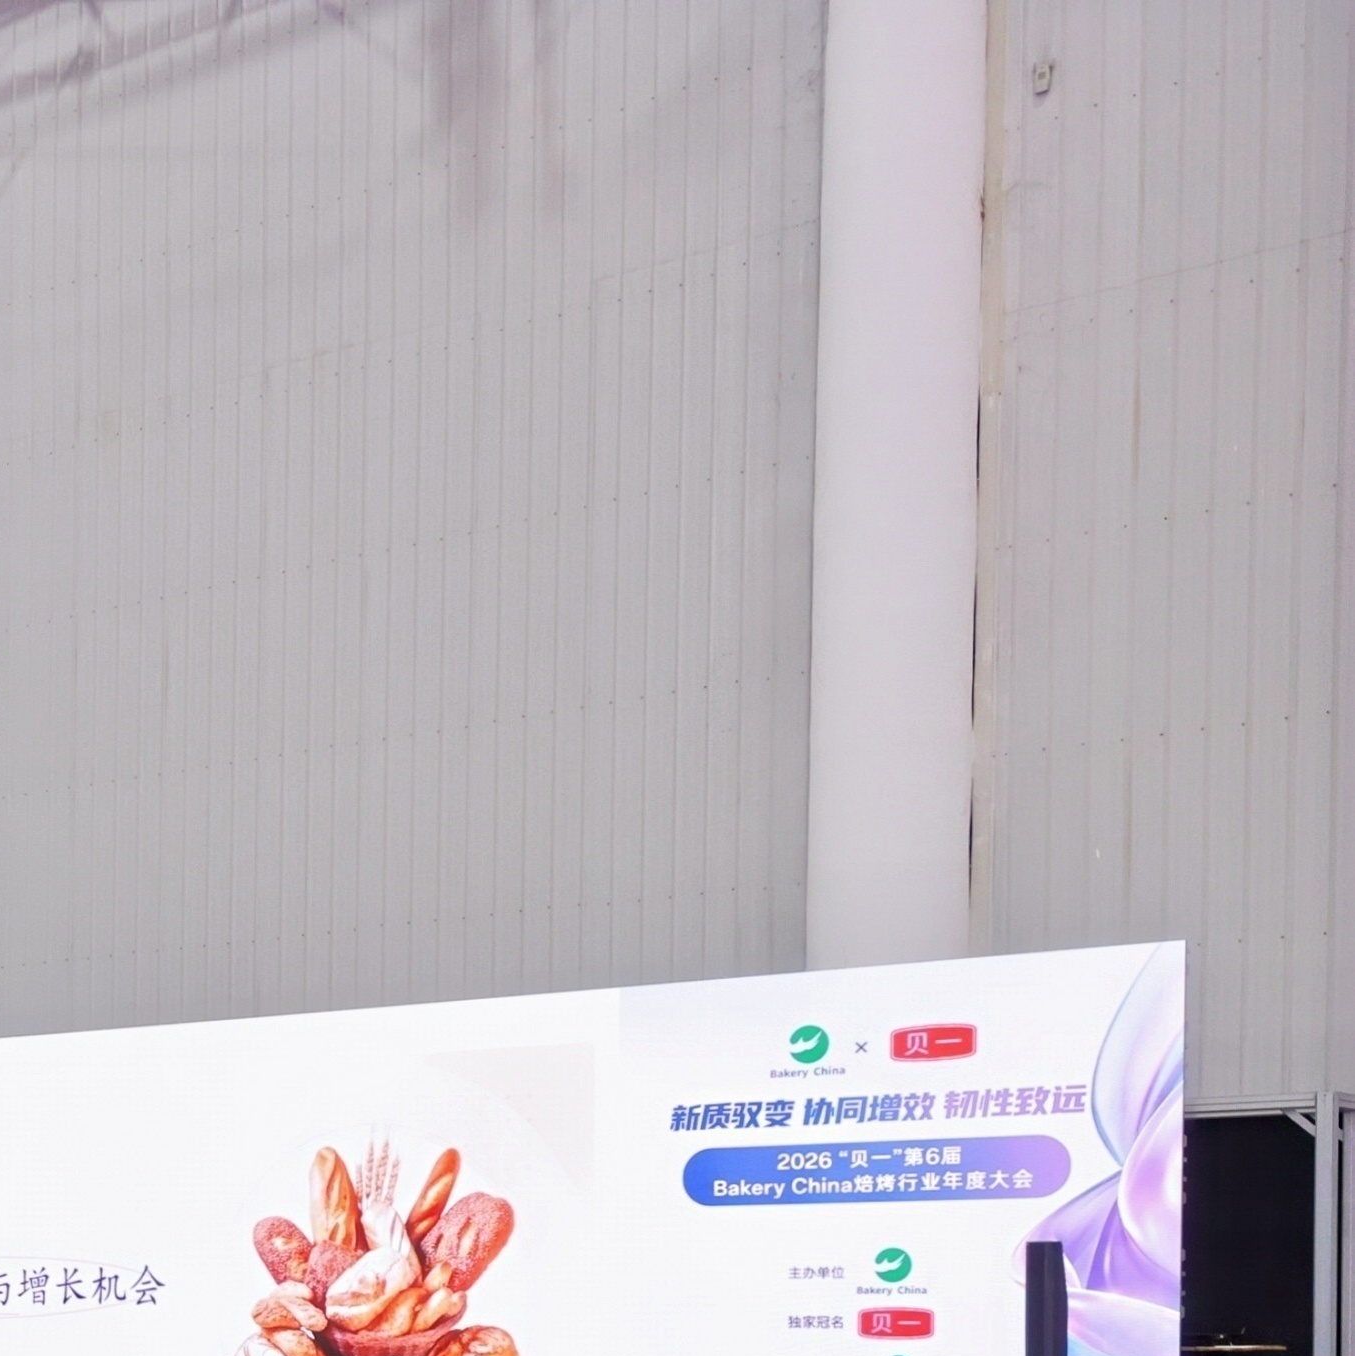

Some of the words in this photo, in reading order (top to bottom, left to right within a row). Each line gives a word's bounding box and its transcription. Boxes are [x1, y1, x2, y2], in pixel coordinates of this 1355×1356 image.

[904, 1032, 962, 1055] 贝一
[770, 1068, 808, 1079] Bakery
[813, 1066, 846, 1076] China
[670, 1100, 794, 1131] 新质驭变
[803, 1092, 935, 1126] 协同增效
[943, 1084, 1087, 1119] 韧性致远
[777, 1152, 832, 1171] 2026
[714, 1179, 785, 1198] Bakery
[788, 1266, 845, 1279] 主办单位
[856, 1286, 892, 1296] Bakery
[897, 1286, 927, 1295] China
[788, 1315, 844, 1329] 独家冠名
[871, 1313, 922, 1334] 贝一
